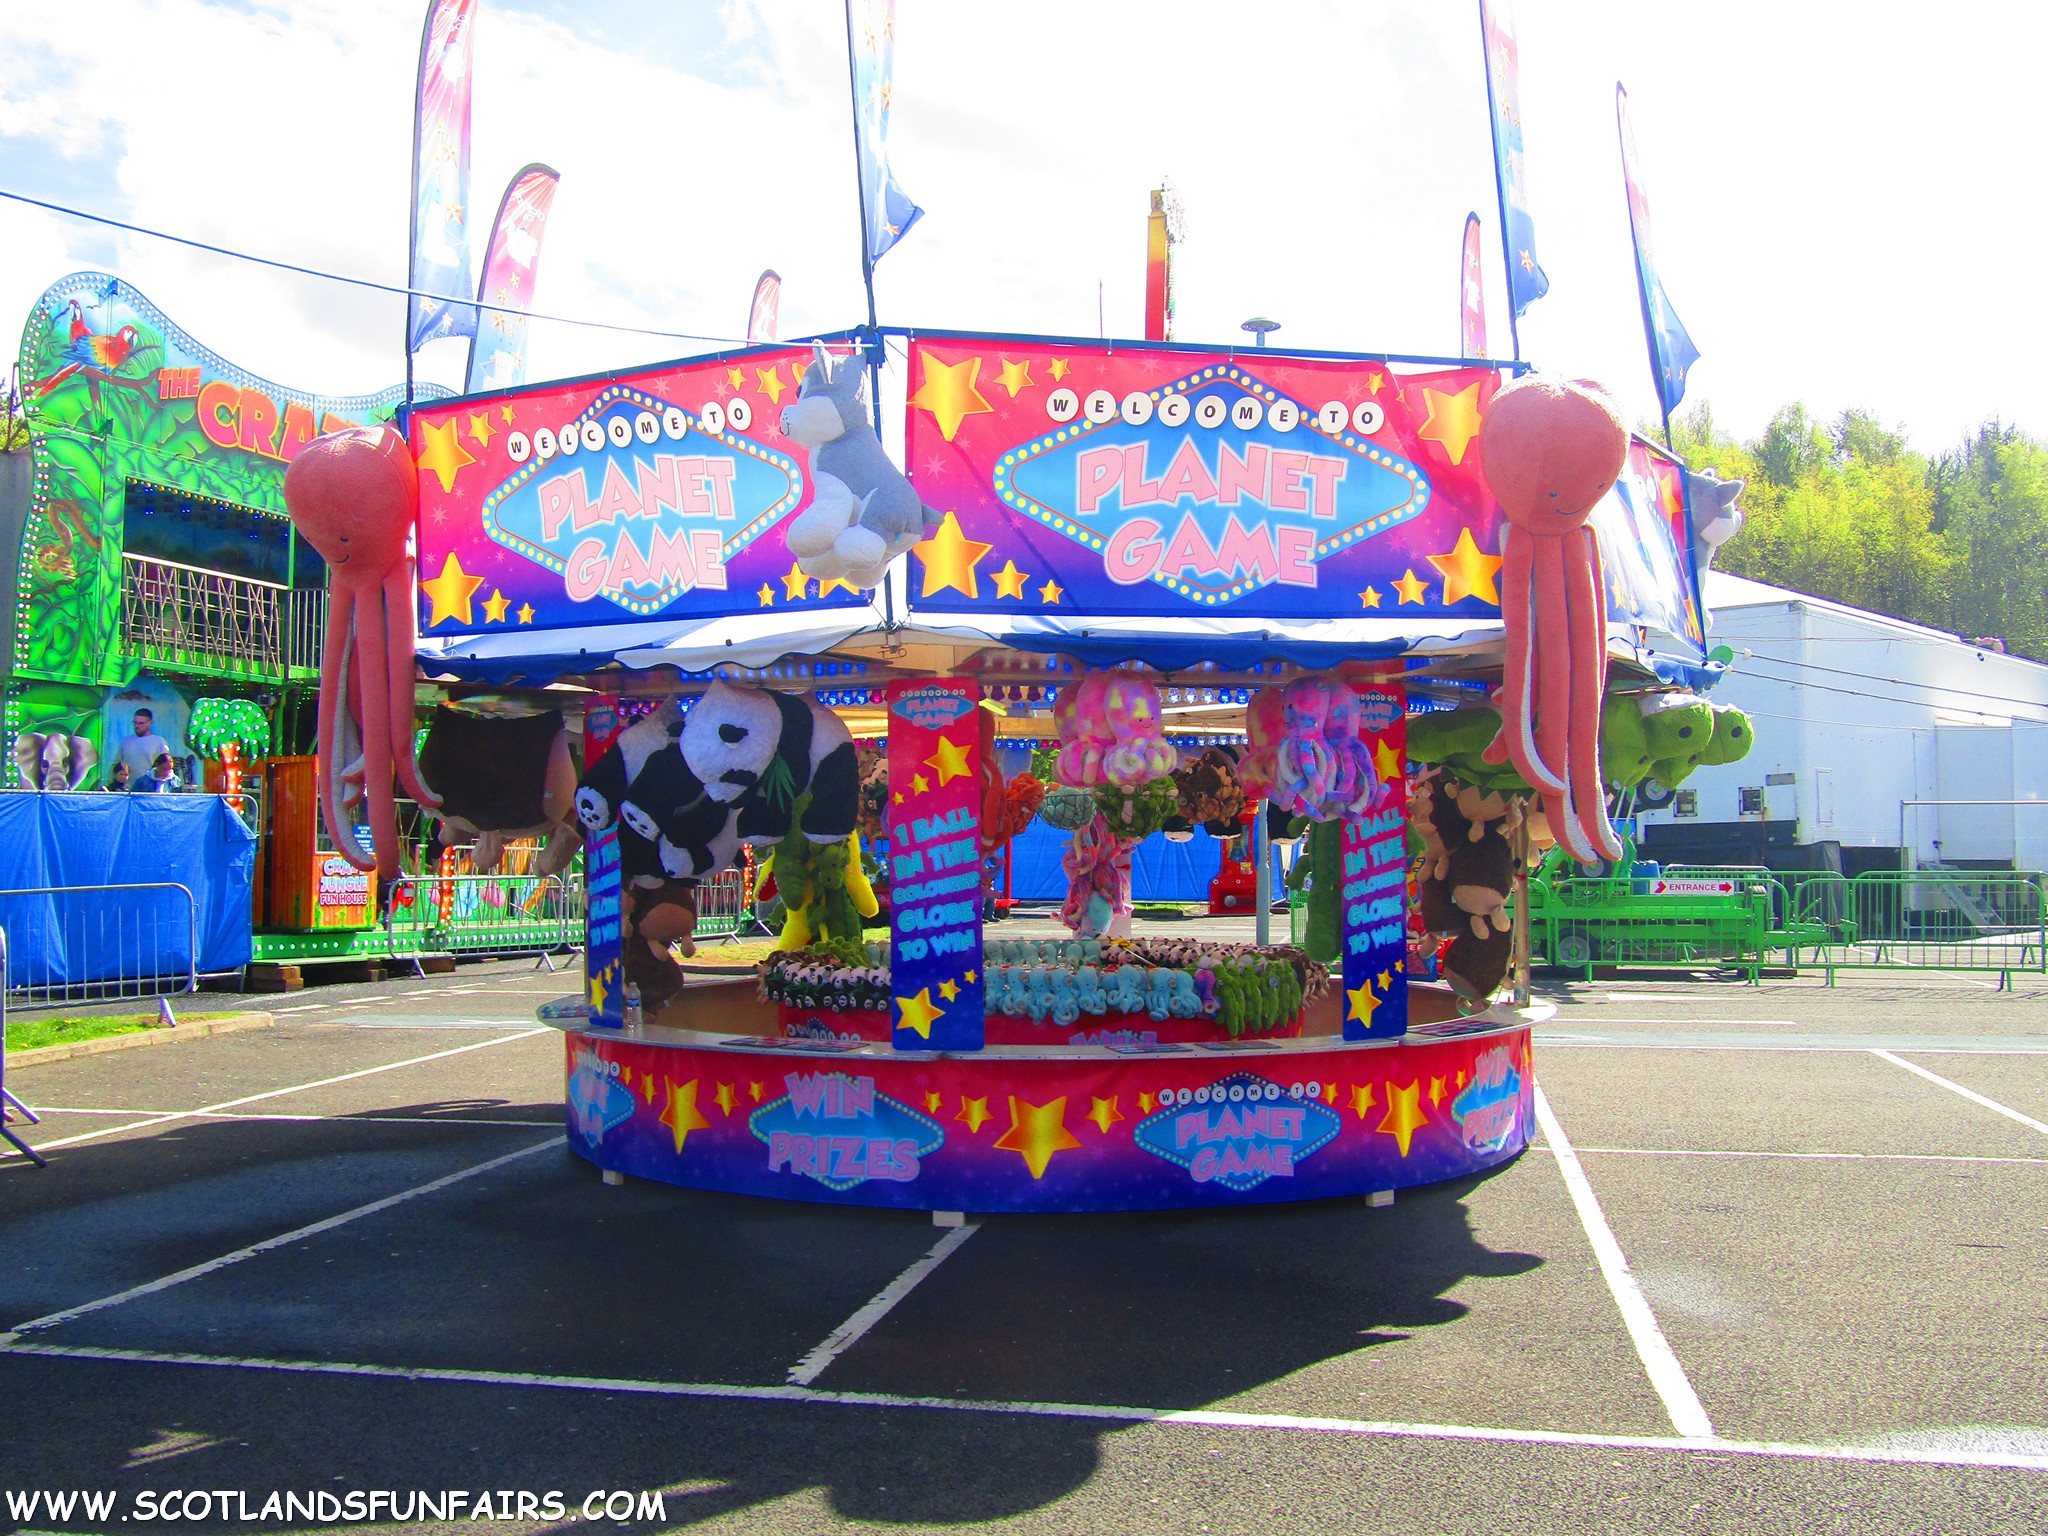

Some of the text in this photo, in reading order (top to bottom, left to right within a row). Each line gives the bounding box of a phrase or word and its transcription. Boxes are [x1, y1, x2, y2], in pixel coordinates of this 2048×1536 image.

[158, 367, 362, 464] THE CRA
[509, 402, 748, 459] WELCOME TO
[1050, 394, 1377, 429] WELCOME TO
[1076, 436, 1347, 517] PLANET
[538, 454, 735, 541] PLANET
[565, 522, 728, 602] GAME
[1104, 512, 1319, 588] GAME
[893, 806, 977, 846] 1 BALL
[1345, 807, 1404, 844] 1 BALL
[324, 857, 365, 876] CRA
[893, 837, 979, 881] IN THE
[1344, 835, 1405, 877] IN THE
[320, 876, 368, 893] JUNGLE
[320, 893, 368, 906] FUN HOUSE
[892, 871, 981, 904] COLOURED
[1669, 883, 1717, 891] ENTRANCE
[897, 900, 976, 933] GLOBE
[1347, 894, 1403, 927] GLOBE
[898, 929, 976, 962] TO WIN
[1348, 922, 1403, 955] TO WIN
[785, 1070, 874, 1120] WIN
[1160, 1082, 1320, 1103] WELCOME TO
[1174, 1104, 1307, 1151] PLANET
[768, 1131, 921, 1183] PRIZES
[1189, 1145, 1295, 1183] GAME
